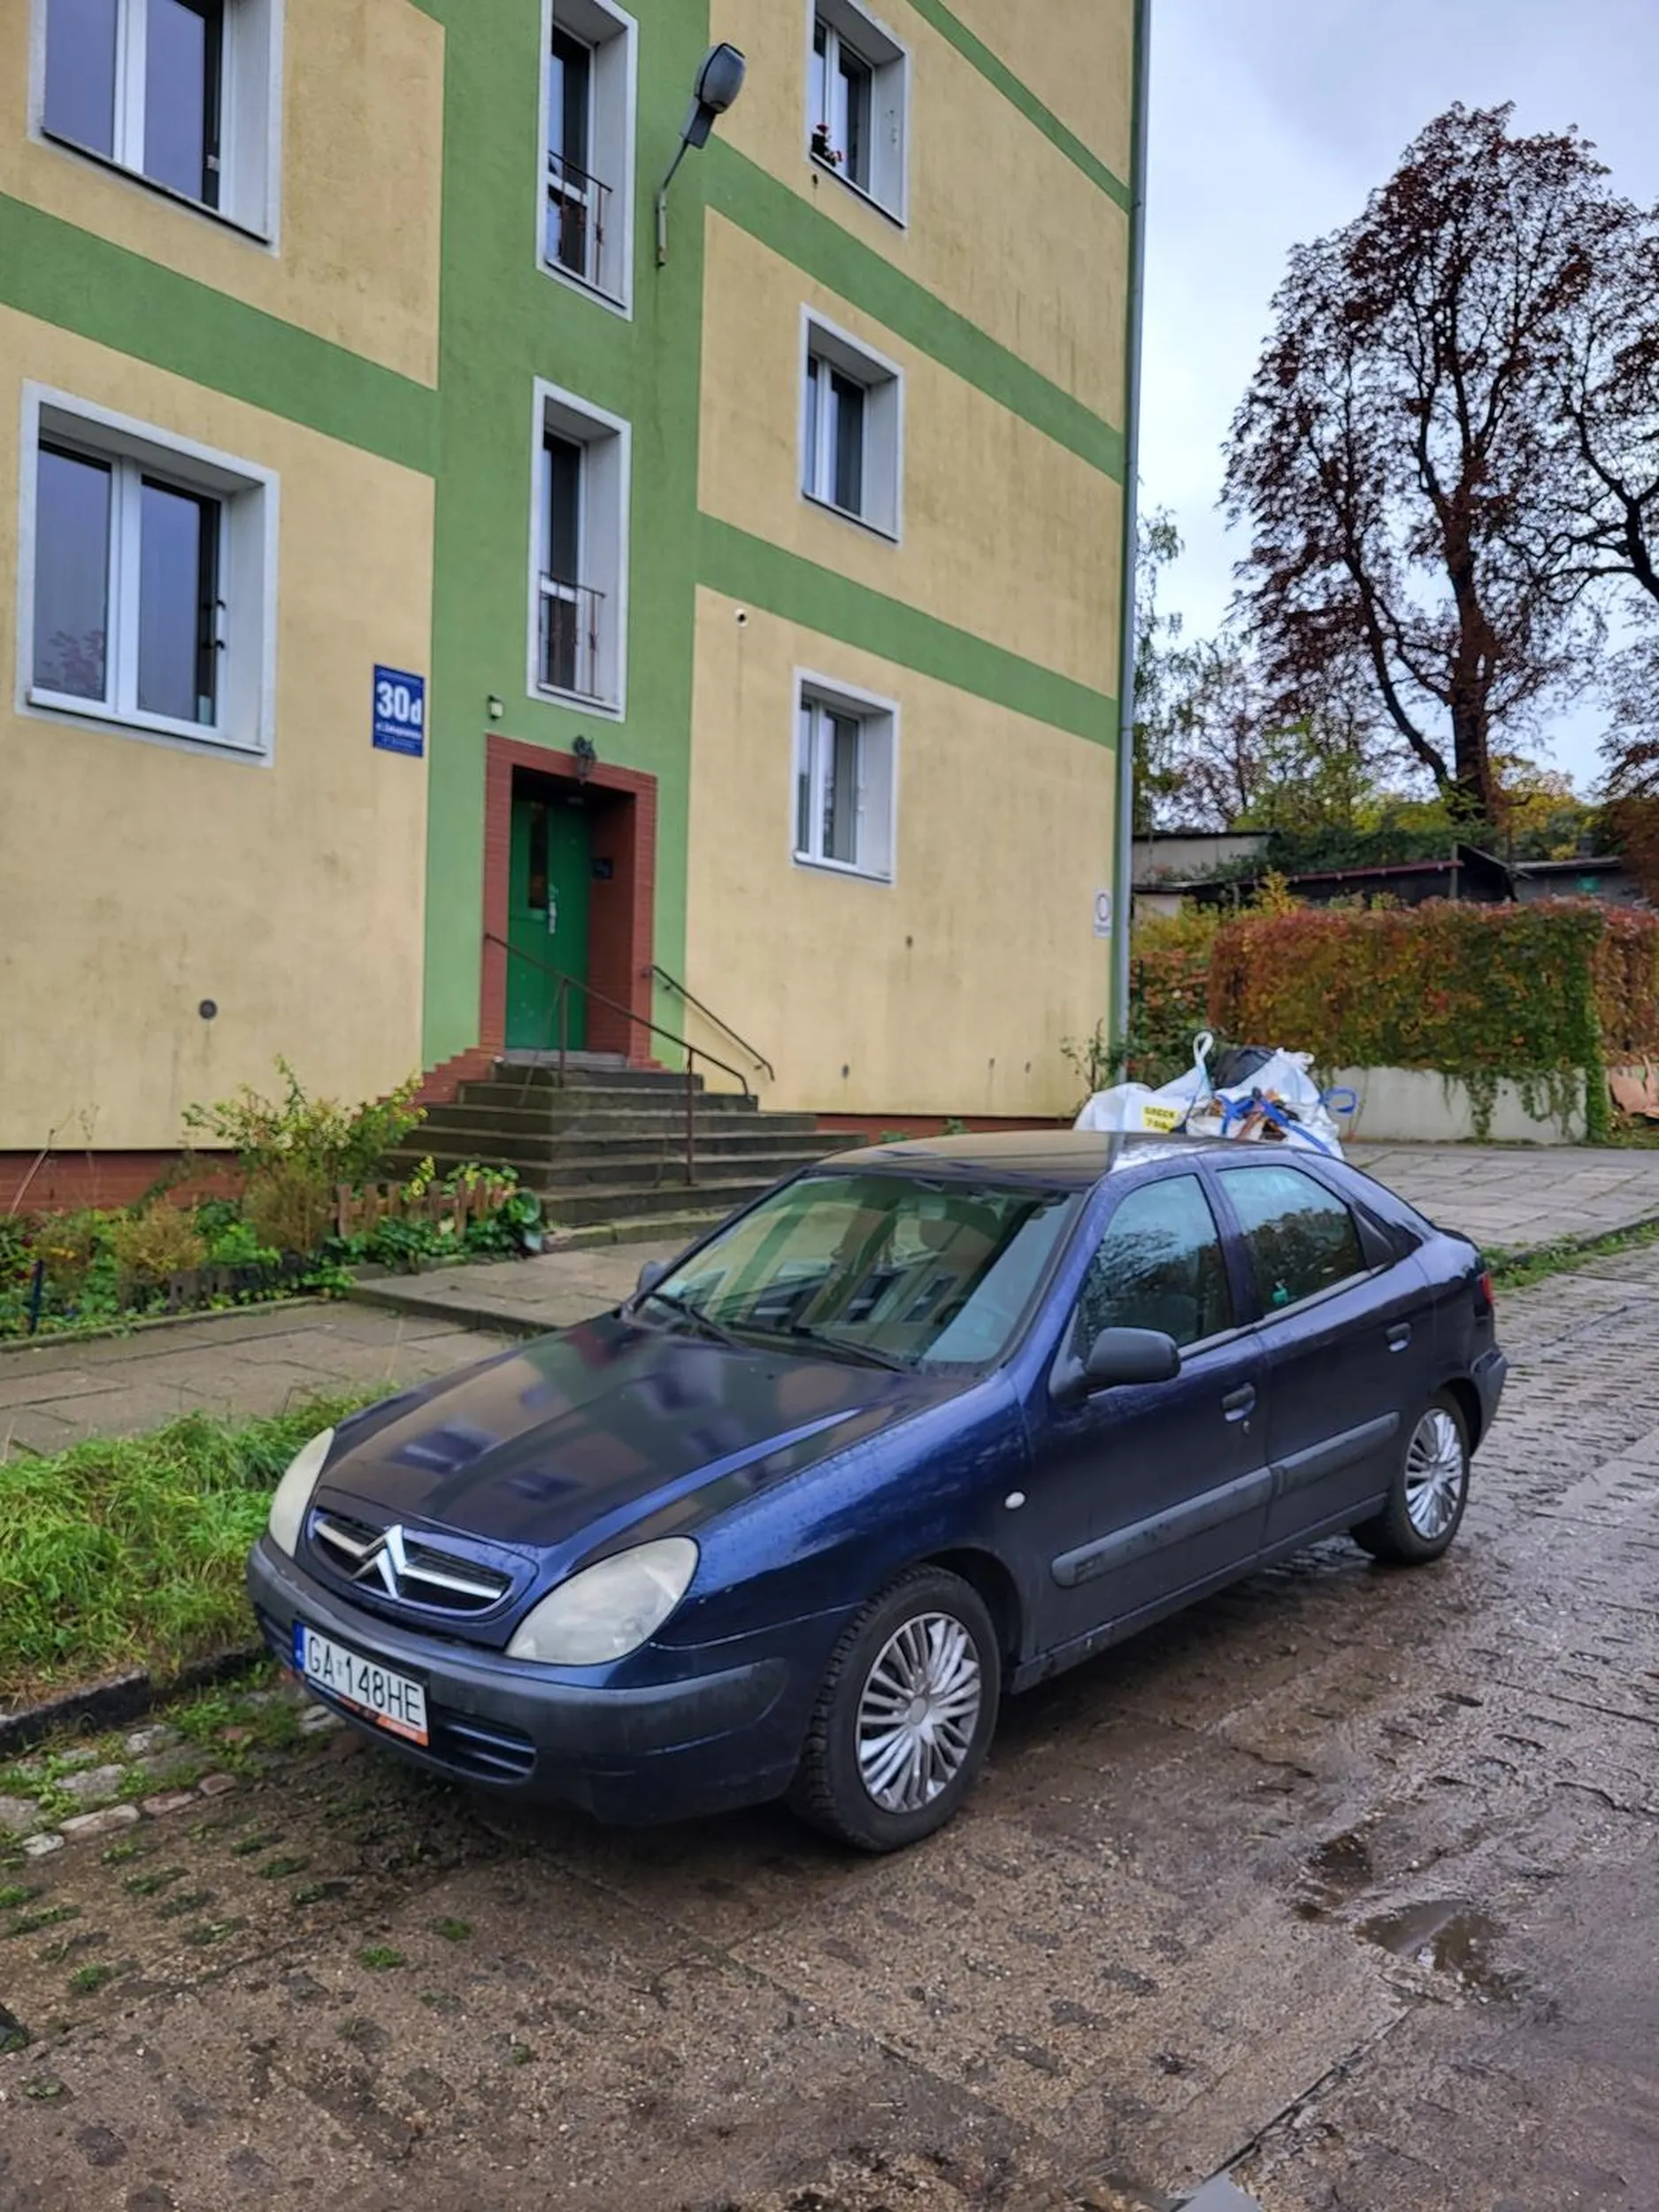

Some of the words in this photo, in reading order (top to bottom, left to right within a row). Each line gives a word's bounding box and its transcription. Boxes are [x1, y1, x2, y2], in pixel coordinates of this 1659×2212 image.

[376, 680, 422, 725] 30d
[309, 1636, 334, 1683] GA
[346, 1655, 421, 1726] 148HE
